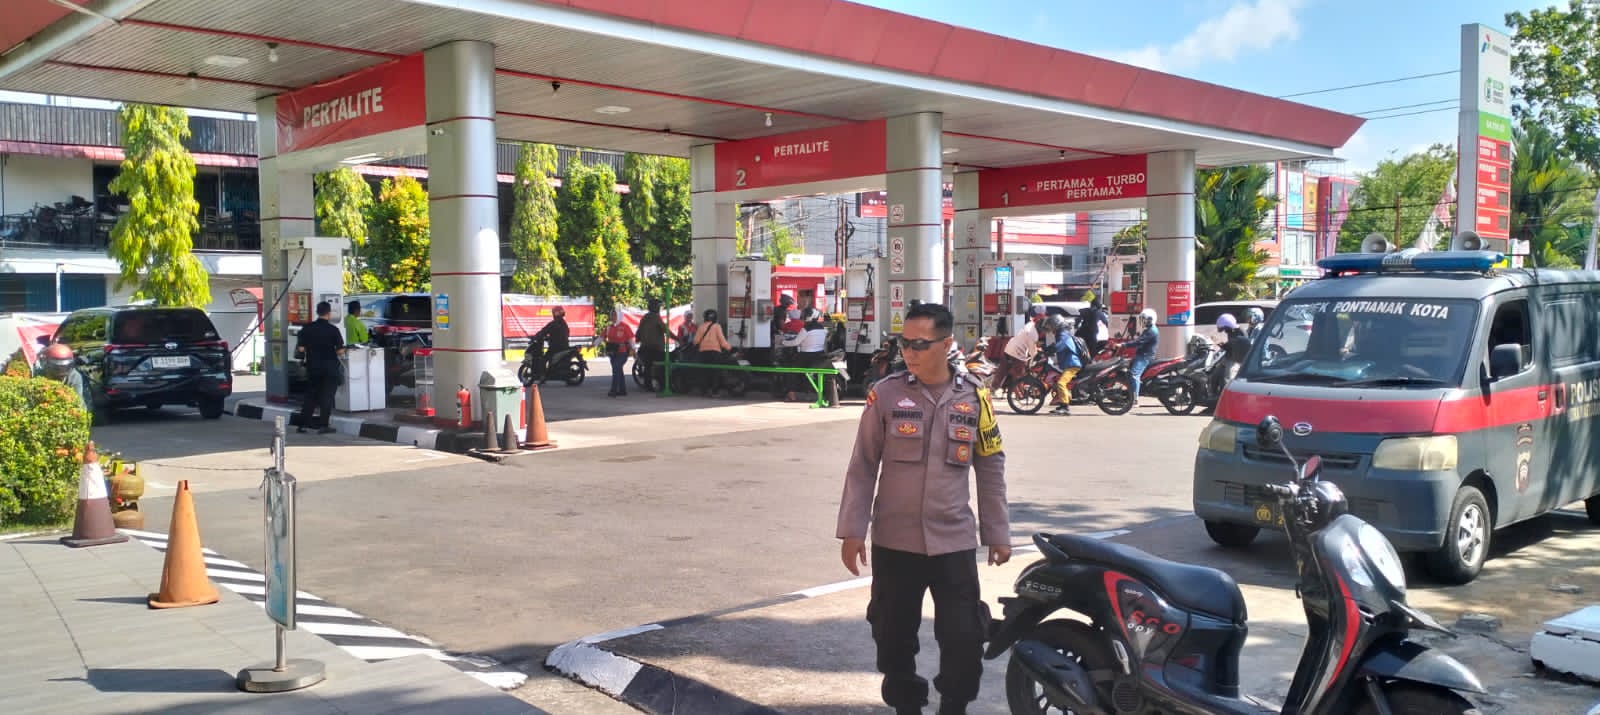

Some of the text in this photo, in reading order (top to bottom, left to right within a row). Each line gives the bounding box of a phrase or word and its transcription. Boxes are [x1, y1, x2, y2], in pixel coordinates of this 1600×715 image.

[304, 88, 383, 128] PERTALITE
[774, 141, 829, 157] PERTALITE
[736, 169, 746, 186] 2
[1036, 173, 1144, 191] PERTAMAX TURBO
[1002, 192, 1009, 205] 1
[1067, 187, 1122, 199] PERTAMAX
[1332, 301, 1406, 315] PONTIANAK
[1410, 303, 1449, 319] KOTA
